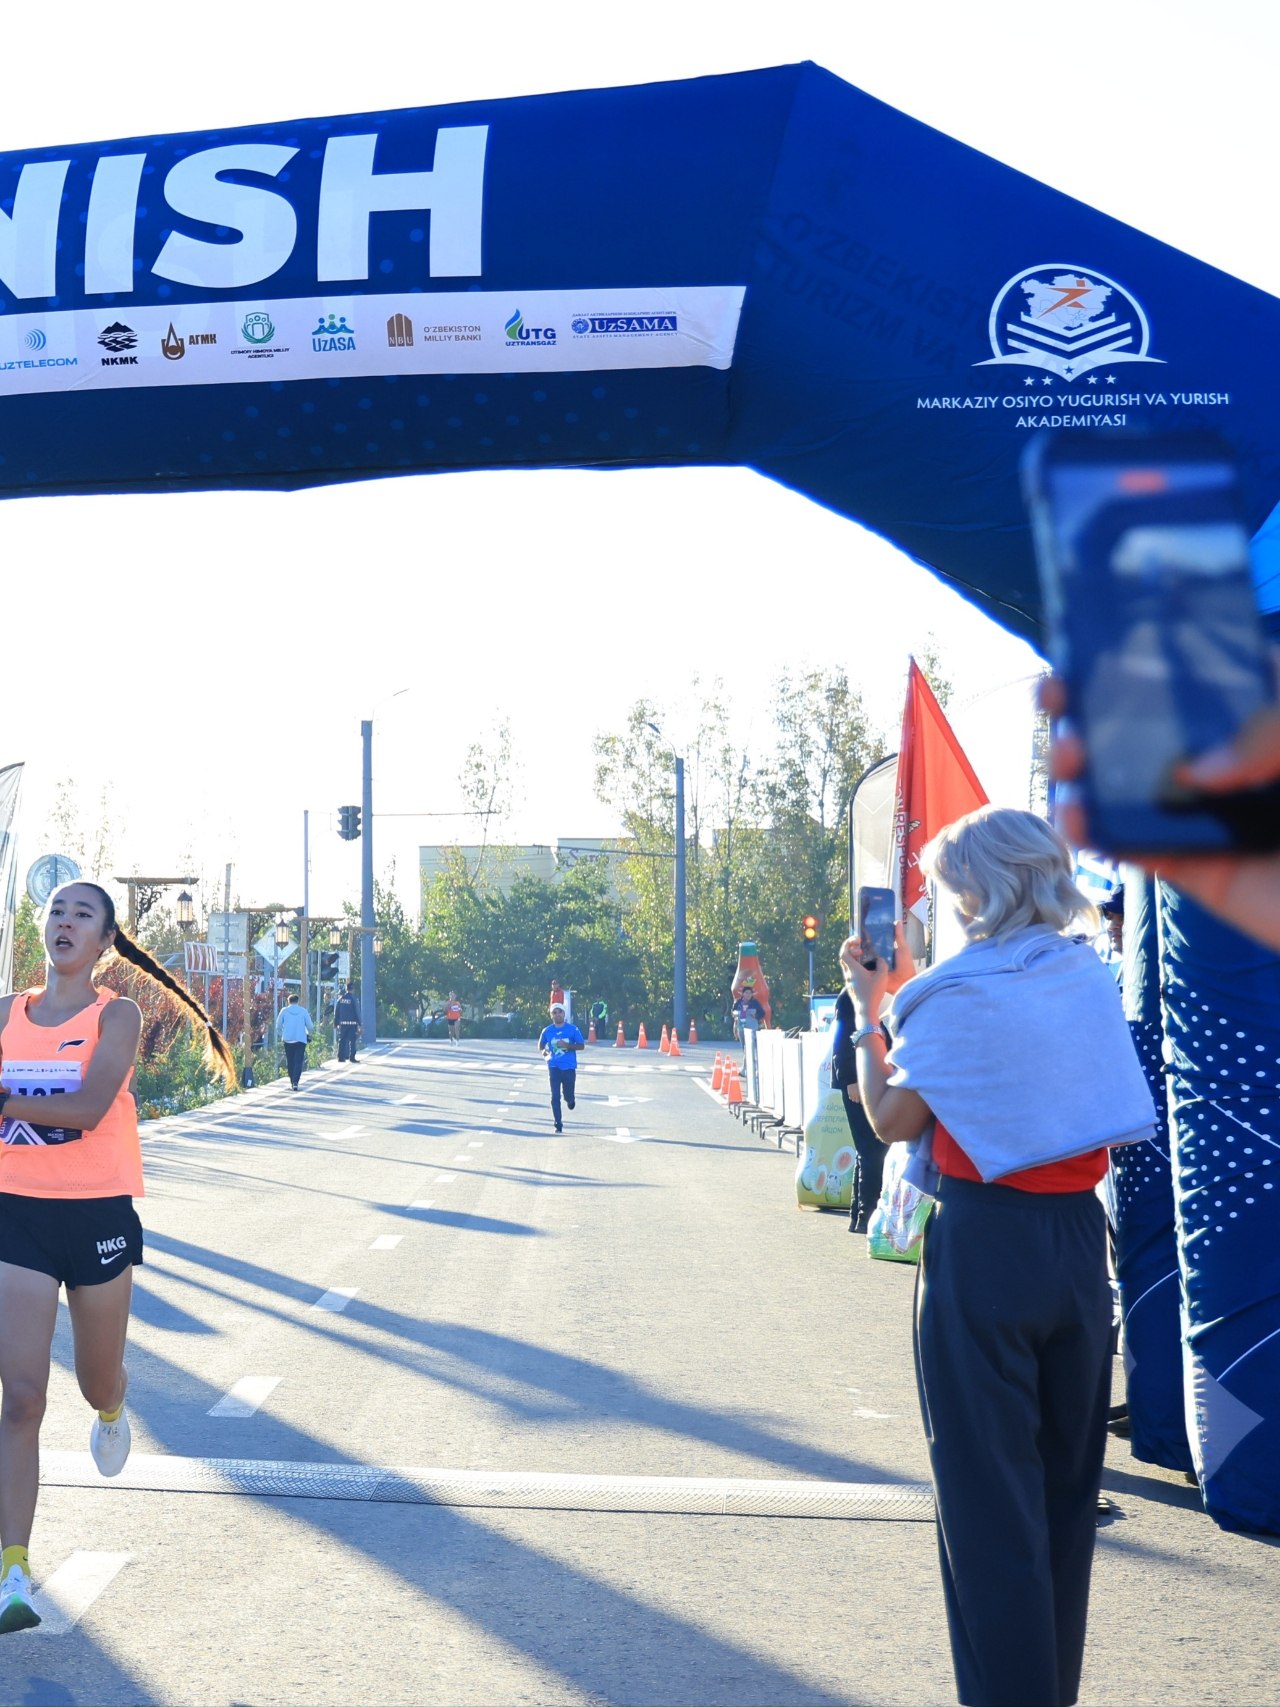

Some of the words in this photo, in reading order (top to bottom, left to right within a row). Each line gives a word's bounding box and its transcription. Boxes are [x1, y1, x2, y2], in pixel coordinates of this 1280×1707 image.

[594, 318, 674, 332] UzSAMA
[518, 328, 557, 340] UTG
[312, 337, 356, 352] UzASA
[101, 356, 138, 366] NKMK
[917, 397, 998, 410] MARKAZIY
[1001, 395, 1054, 409] OSIYO
[1057, 393, 1140, 407] YUGURISH
[1144, 393, 1168, 405] VA
[1169, 391, 1229, 405] YURISH
[1015, 413, 1126, 428] AKADEMIYASI
[96, 1236, 127, 1254] HKG
